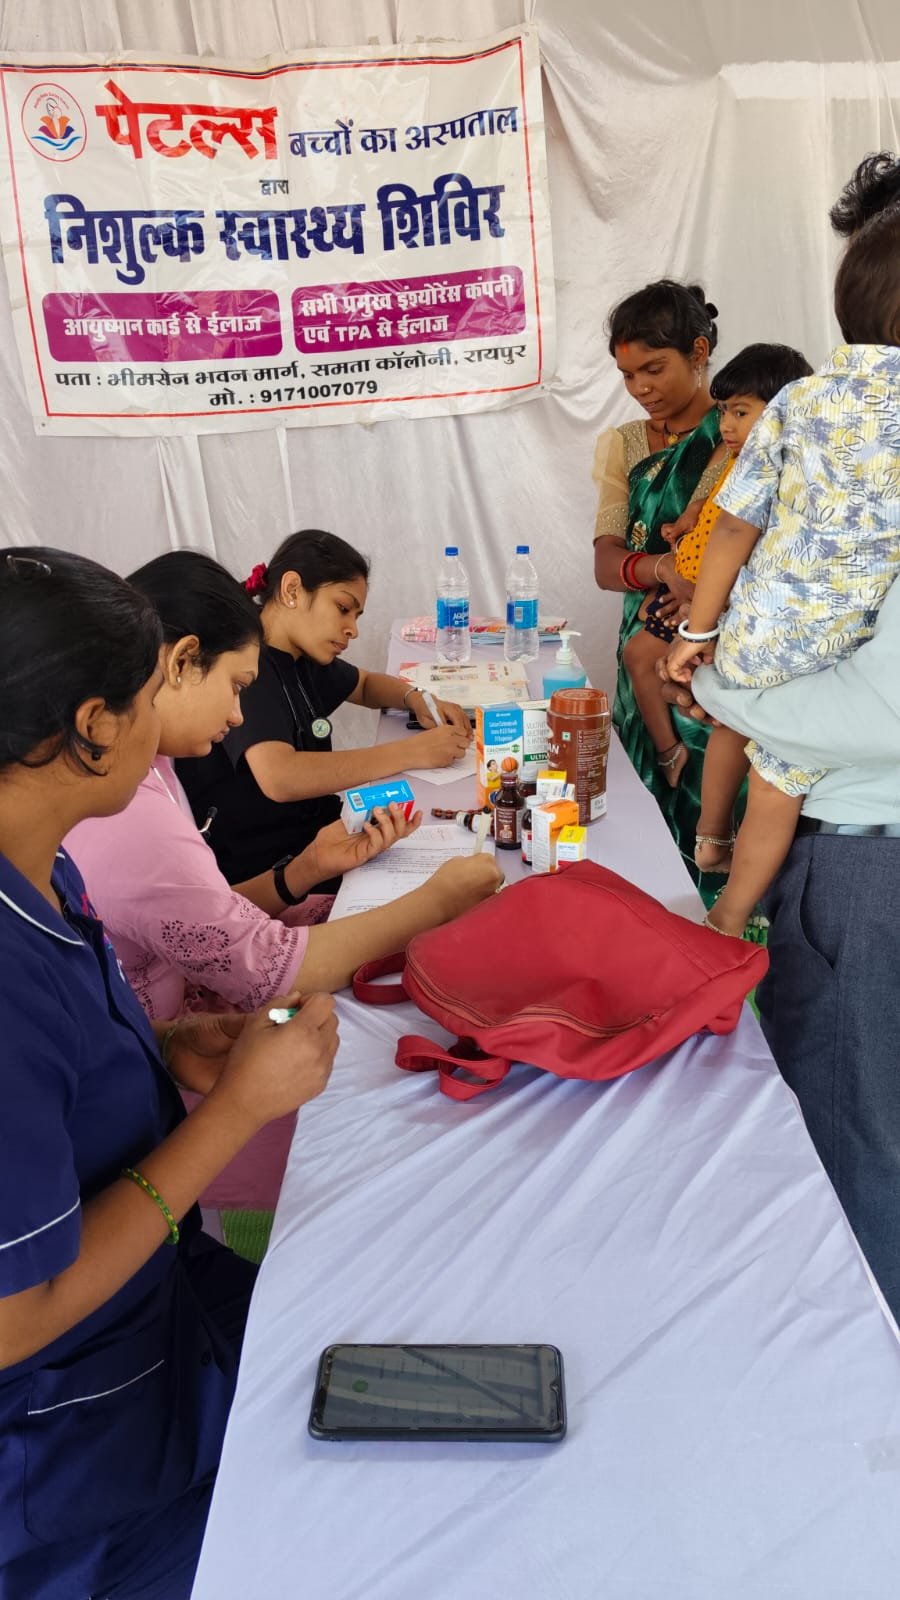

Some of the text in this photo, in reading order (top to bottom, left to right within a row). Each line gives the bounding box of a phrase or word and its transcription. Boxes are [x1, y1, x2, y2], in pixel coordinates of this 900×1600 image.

[95, 79, 518, 159] पेटल्स बच्चों का अस्पताल
[259, 179, 289, 195] द्वारा
[44, 173, 505, 285] निशुल्क स्वास्थ्य शिविर
[300, 294, 338, 316] सभी
[342, 292, 392, 317] प्रमुख
[464, 274, 514, 300] कंपनी
[63, 311, 262, 342] आयुष्मान कार्ड से ईलाज
[302, 313, 449, 343] एवं TPA से ईलाज
[55, 373, 90, 386] पता
[107, 368, 189, 386] भीमसेन
[195, 369, 248, 385] भवन
[311, 359, 370, 377] समता
[463, 344, 527, 365] रायपुर
[260, 380, 378, 404] 9171007079
